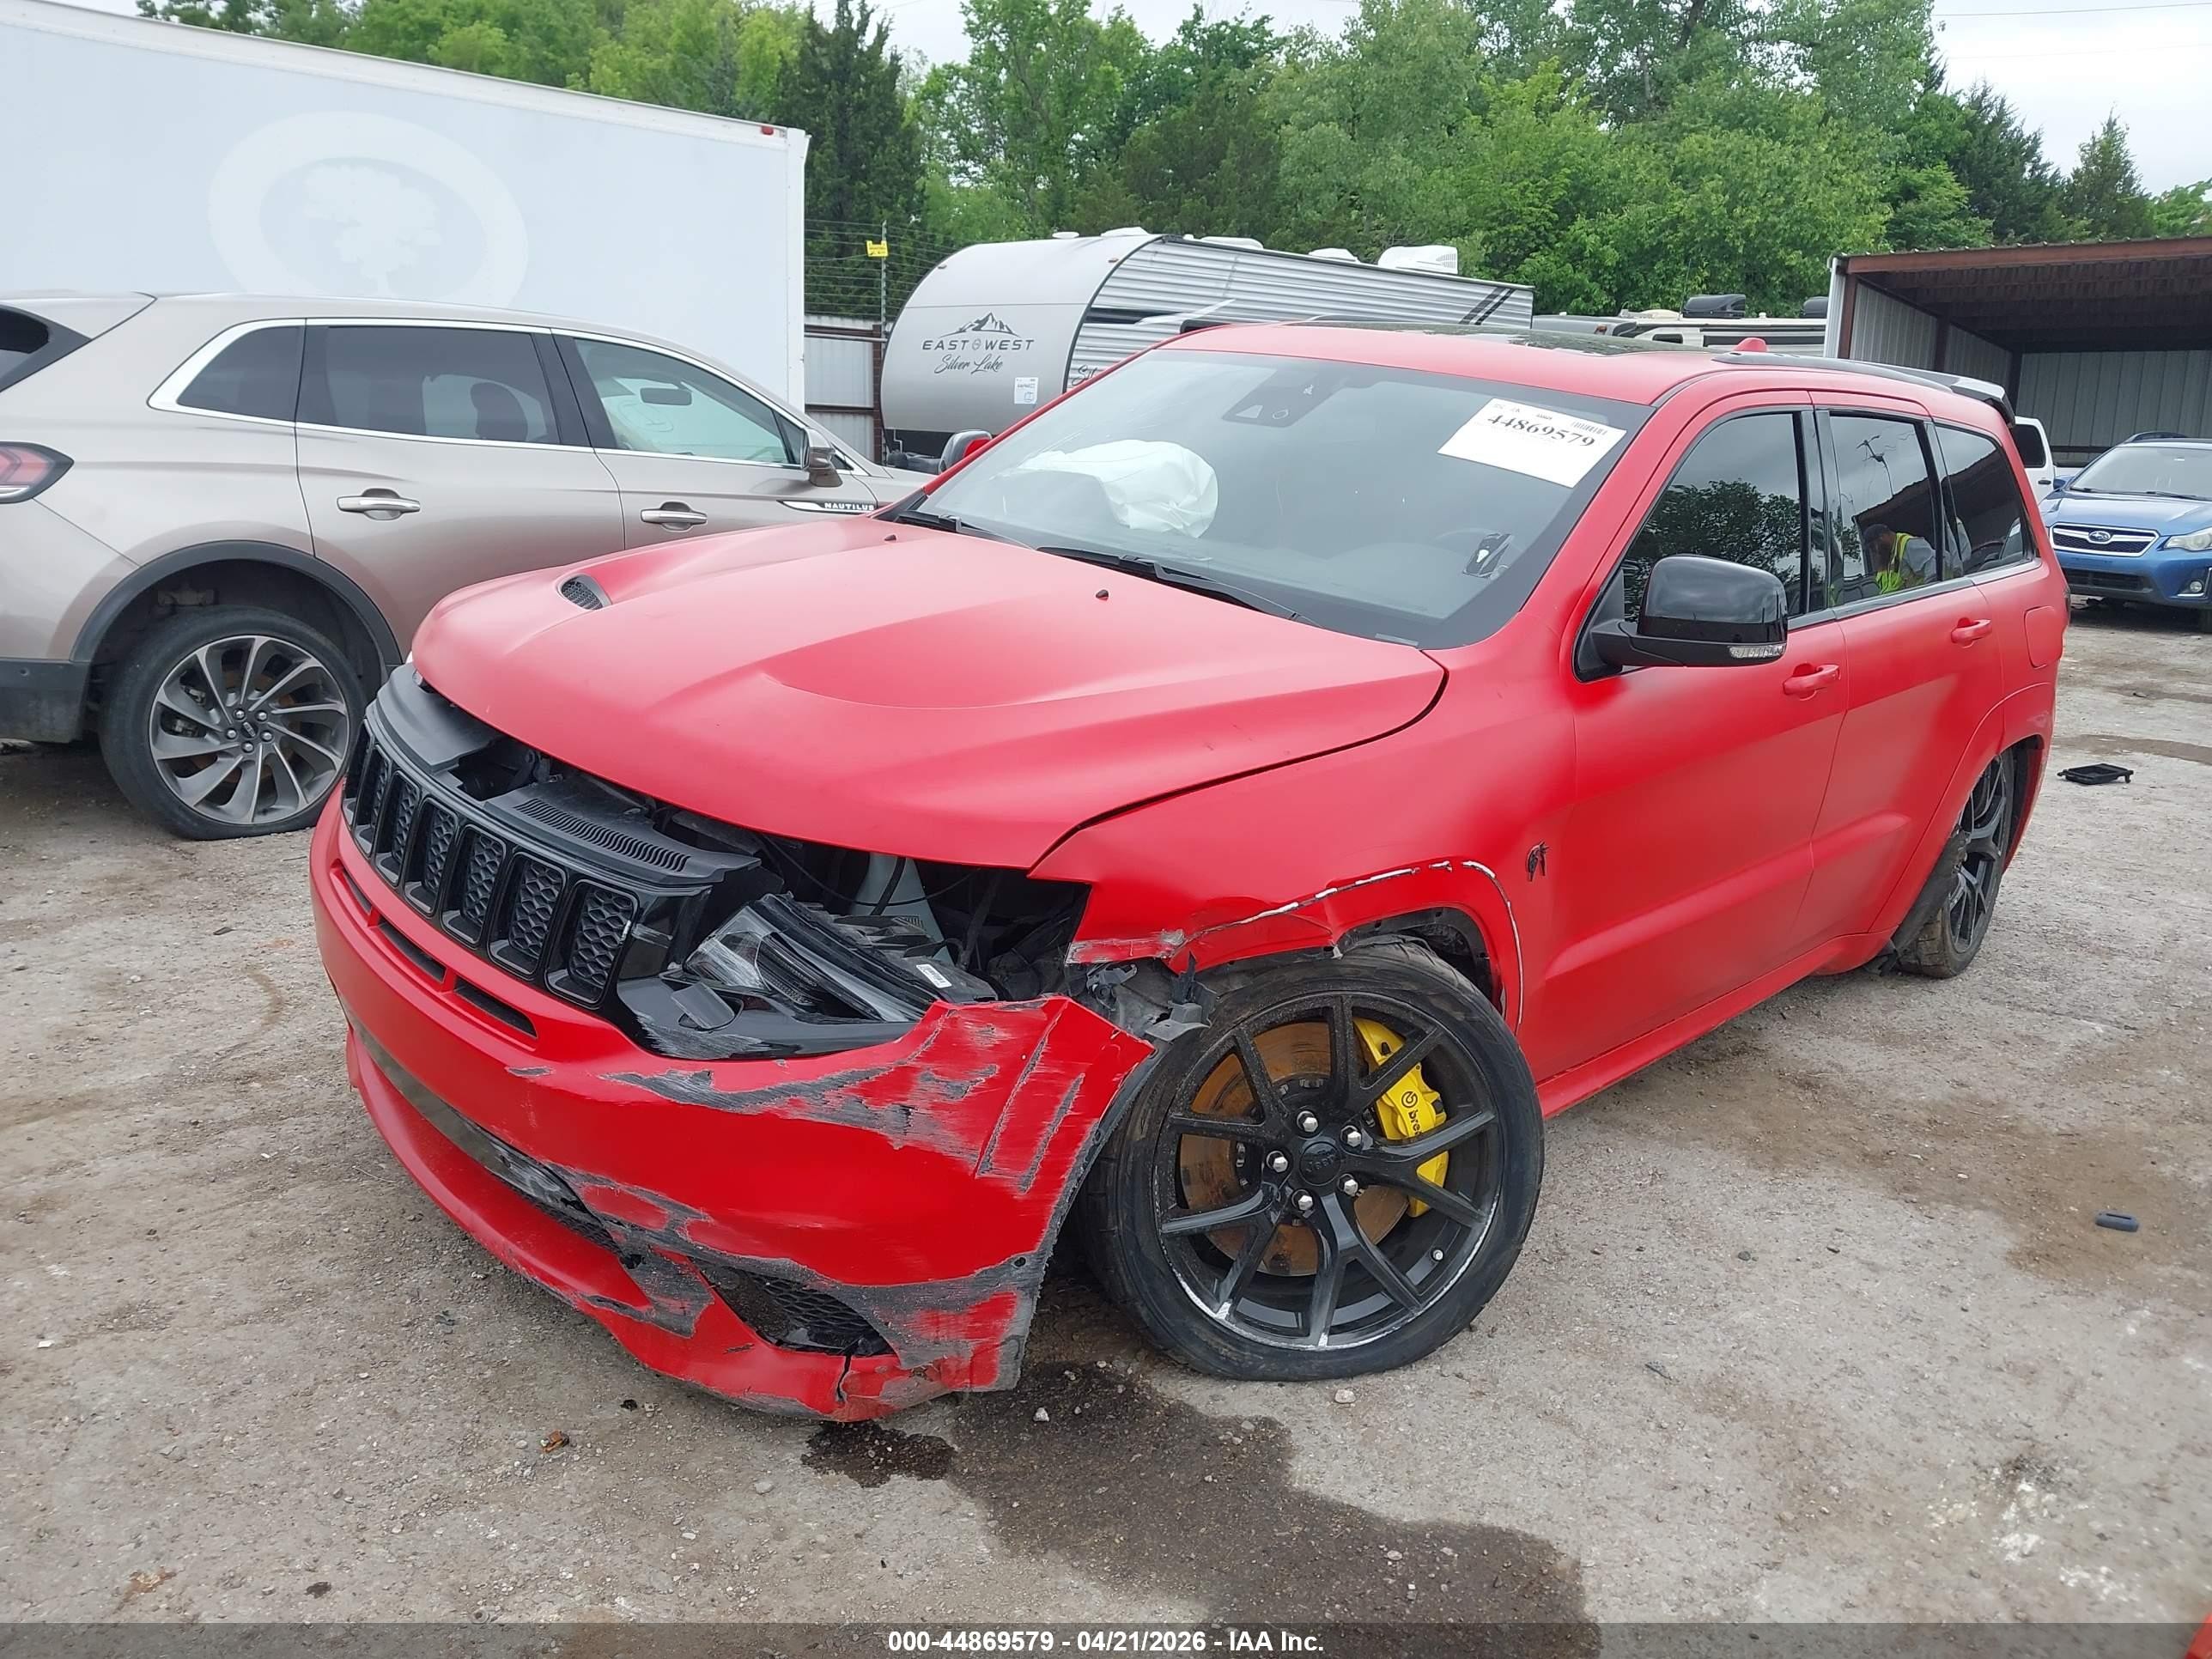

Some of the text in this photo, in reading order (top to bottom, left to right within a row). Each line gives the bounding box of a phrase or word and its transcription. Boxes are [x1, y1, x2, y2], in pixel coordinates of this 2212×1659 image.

[922, 339, 1035, 350] EAST WEST
[933, 353, 1004, 375] Silver Lake
[1487, 415, 1595, 446] 44869579
[823, 502, 875, 511] NAUTILUS
